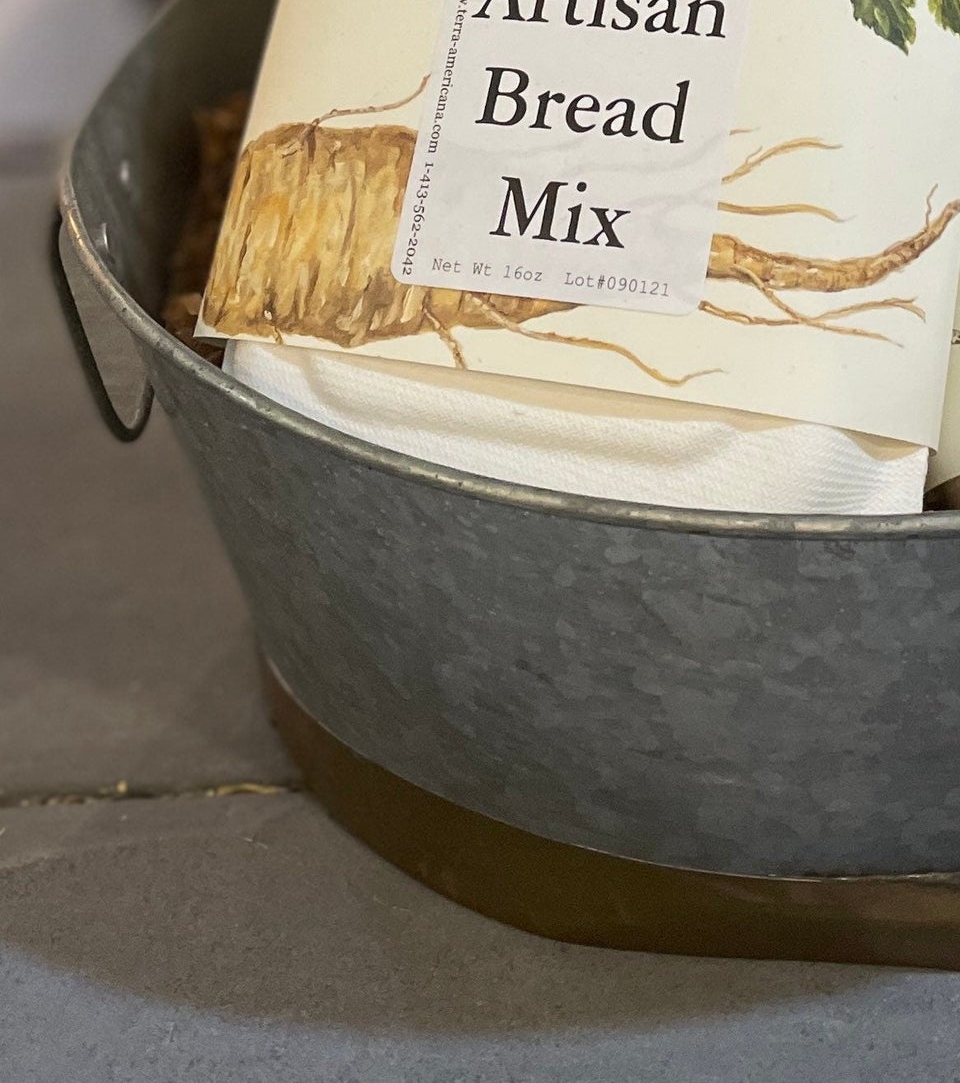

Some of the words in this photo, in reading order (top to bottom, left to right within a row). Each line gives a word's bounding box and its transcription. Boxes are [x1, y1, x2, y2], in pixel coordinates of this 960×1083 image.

[474, 66, 691, 144] Bread
[401, 161, 434, 276] 1-413-562-2042
[488, 175, 632, 249] Mix
[431, 257, 462, 275] Net
[472, 262, 492, 278] Wt
[503, 264, 544, 283] 16oz
[564, 271, 670, 297] Lot#090121
